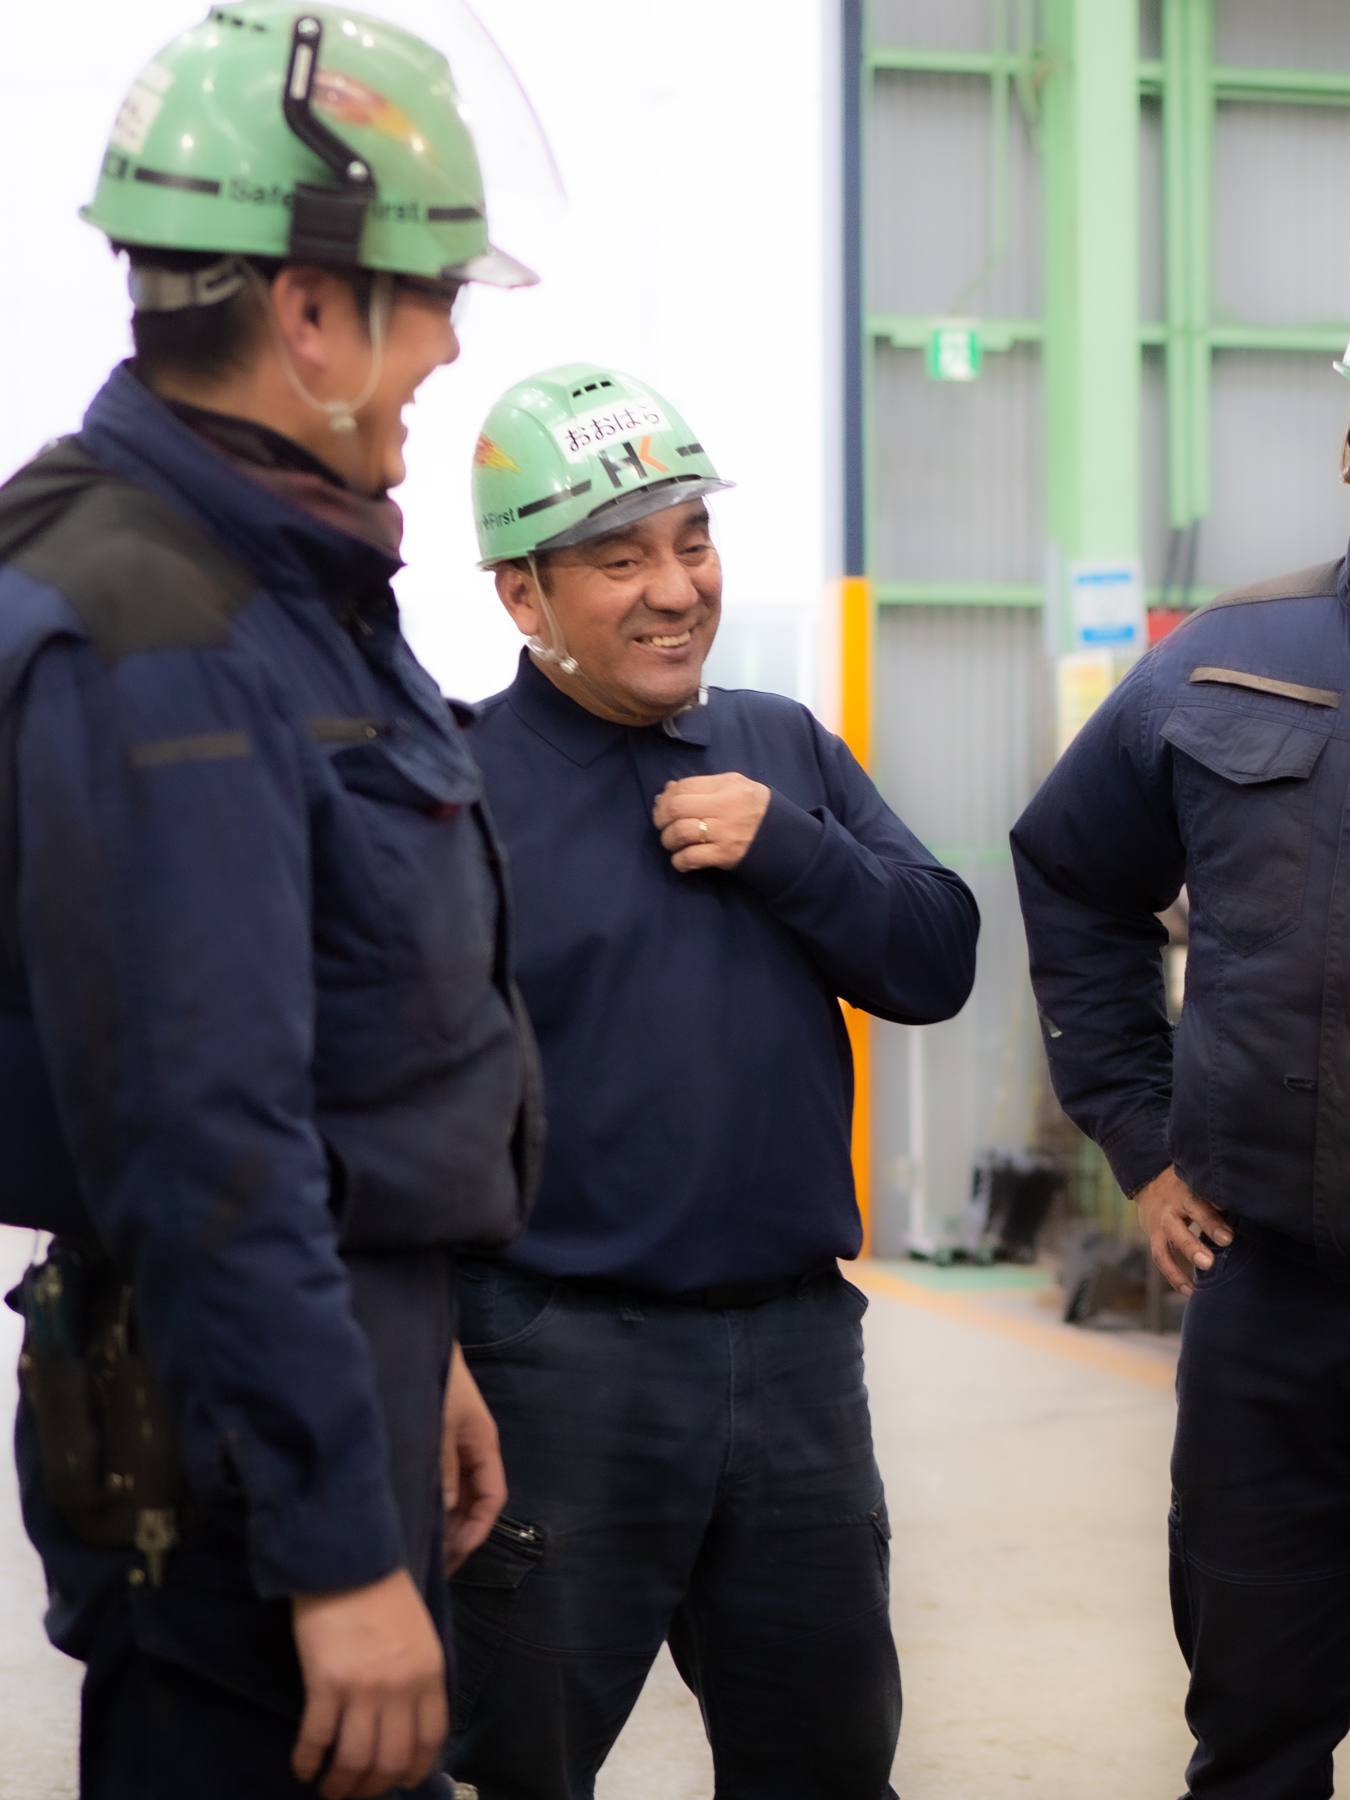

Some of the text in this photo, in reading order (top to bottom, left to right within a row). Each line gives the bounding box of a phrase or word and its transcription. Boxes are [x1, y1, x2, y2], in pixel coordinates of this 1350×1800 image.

[565, 405, 660, 452] おおはら
[597, 434, 670, 489] HK
